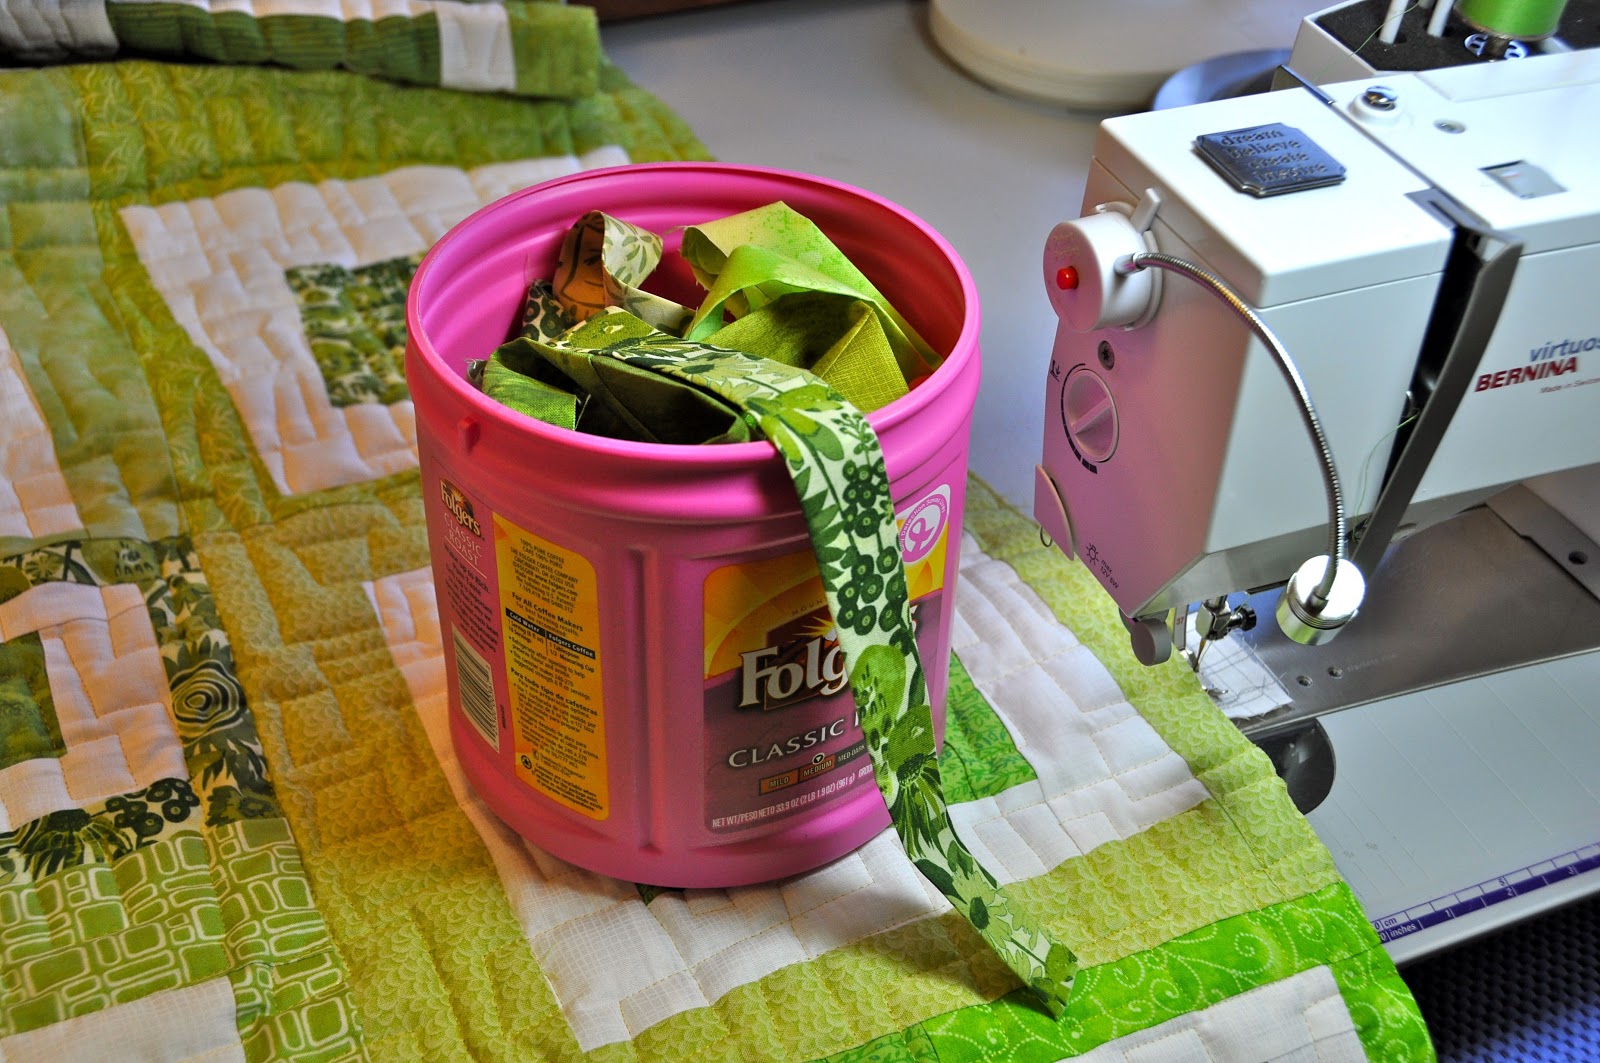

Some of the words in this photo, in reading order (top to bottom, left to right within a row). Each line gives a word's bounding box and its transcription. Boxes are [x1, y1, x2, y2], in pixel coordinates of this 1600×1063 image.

[1220, 129, 1285, 146] dream
[1226, 139, 1301, 158] believe
[1249, 152, 1309, 169] create
[1474, 356, 1577, 392] BERNINA
[440, 480, 481, 536] Folgers
[444, 512, 483, 557] CLASSIC
[449, 529, 479, 566] ROAST
[510, 612, 521, 623] Cold
[522, 618, 539, 632] Water
[512, 592, 522, 601] For
[524, 599, 532, 607] All
[534, 605, 556, 619] Coffee
[558, 616, 583, 631] Makers
[549, 634, 571, 648] Folgers
[572, 644, 593, 657] Coffee
[738, 637, 848, 708] Folg
[511, 667, 523, 679] Para
[524, 676, 539, 688] todo
[541, 686, 554, 696] tipo
[566, 699, 597, 716] cafeteras
[728, 719, 844, 767] CLASSIC
[769, 776, 789, 788] MILD
[803, 760, 832, 776] MEDIUM
[712, 817, 726, 828] NET
[726, 810, 758, 825] WT/PESO
[758, 806, 774, 819] NETO
[776, 802, 790, 814] 33.9
[791, 799, 799, 809] OZ
[1384, 918, 1397, 927] cm
[1499, 879, 1506, 887] 5
[1389, 923, 1416, 938] inches
[1445, 909, 1451, 918] 1
[1507, 888, 1514, 896] 2
